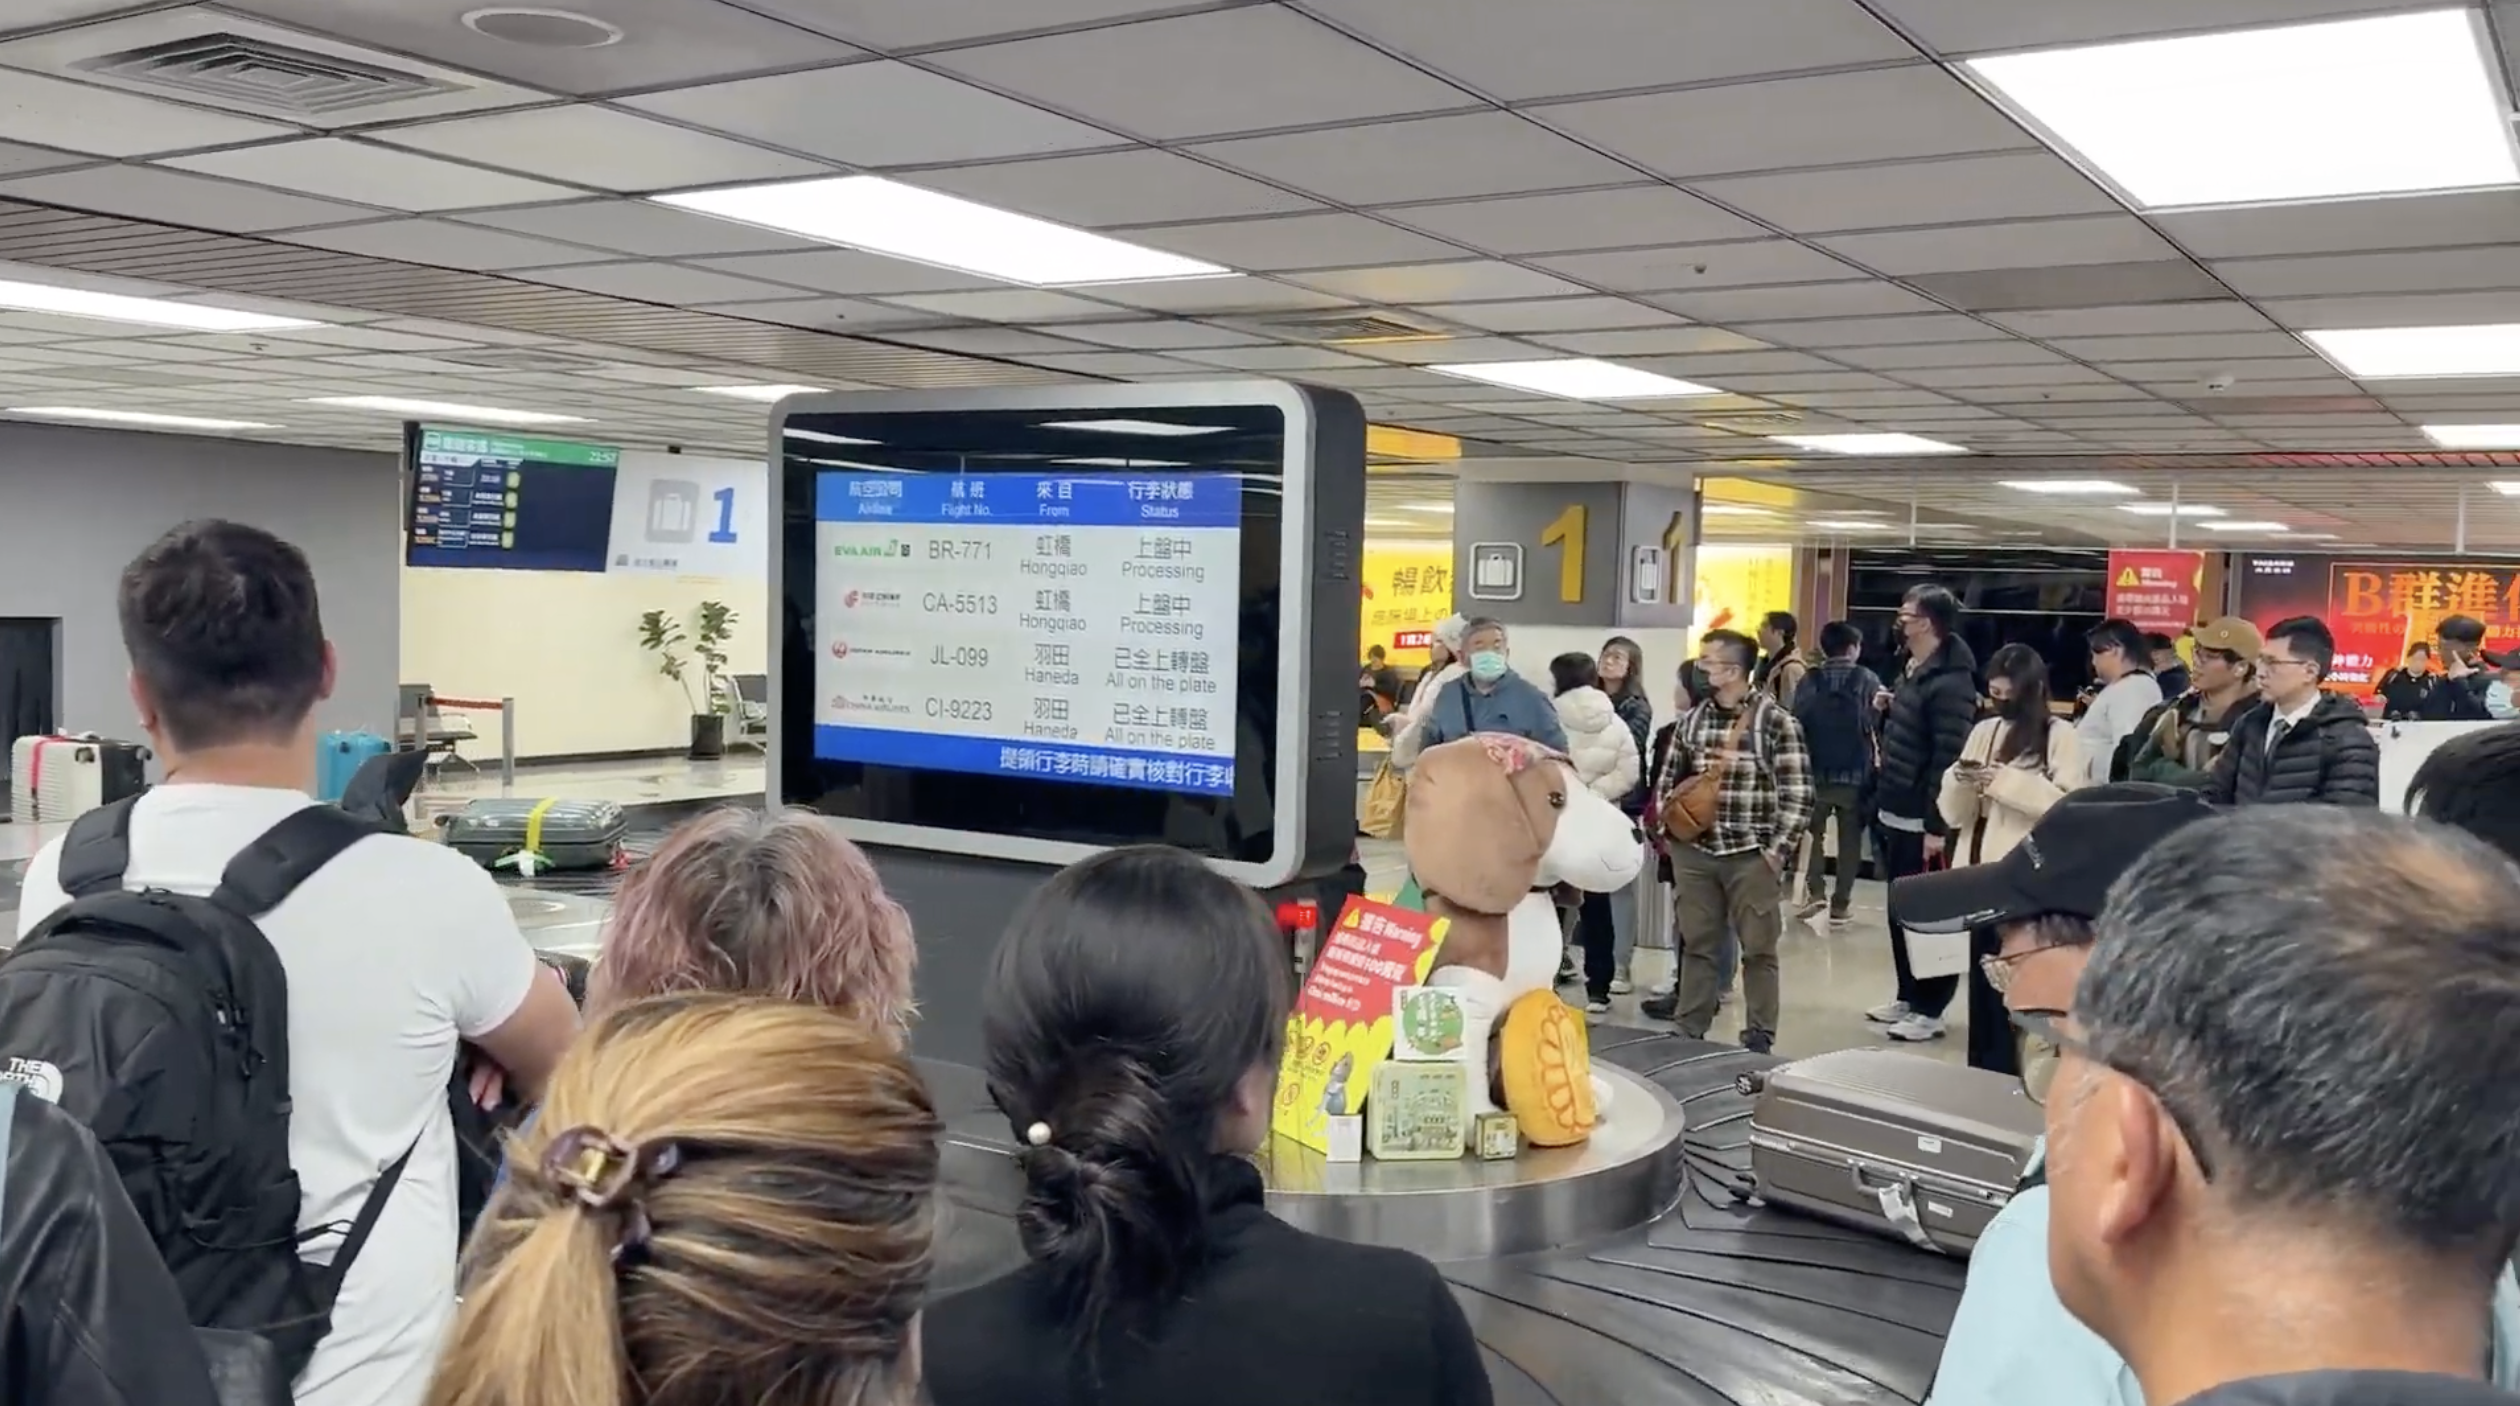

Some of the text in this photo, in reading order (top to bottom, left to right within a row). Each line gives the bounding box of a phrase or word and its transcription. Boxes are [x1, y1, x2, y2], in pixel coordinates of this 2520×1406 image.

[1128, 481, 1193, 500] 行李狀態
[708, 487, 738, 544] 1
[941, 503, 993, 518] Flight No.
[1039, 504, 1069, 517] From
[1141, 504, 1179, 518] Status
[929, 540, 991, 560] BR-771
[1036, 534, 1071, 557] 虹橋
[1134, 537, 1192, 560] 上盤中
[1541, 504, 1588, 603] 1
[1663, 511, 1686, 604] 1
[1020, 560, 1087, 579] Hongqiao
[1122, 561, 1205, 583] Processing
[1393, 565, 1454, 597] 暢飲
[923, 592, 998, 615] CA-5513
[1035, 589, 1071, 612] 虹橋
[1134, 592, 1191, 616] 上盤中
[1019, 613, 1087, 633] Hongqiao
[1120, 616, 1204, 640] Processing
[930, 645, 989, 667] JL-099
[1034, 643, 1069, 667] 羽田
[1114, 647, 1210, 675] 已全上轉盤
[1025, 667, 1079, 685] Haneda
[1105, 672, 1217, 694] All on the plate
[925, 697, 993, 721] CI-9223
[1034, 698, 1069, 721] 羽田
[1113, 702, 1209, 731] 已全上轉盤
[1024, 721, 1078, 739] Haneda
[1105, 727, 1216, 750] All on the plate
[9, 1057, 42, 1073] THE
